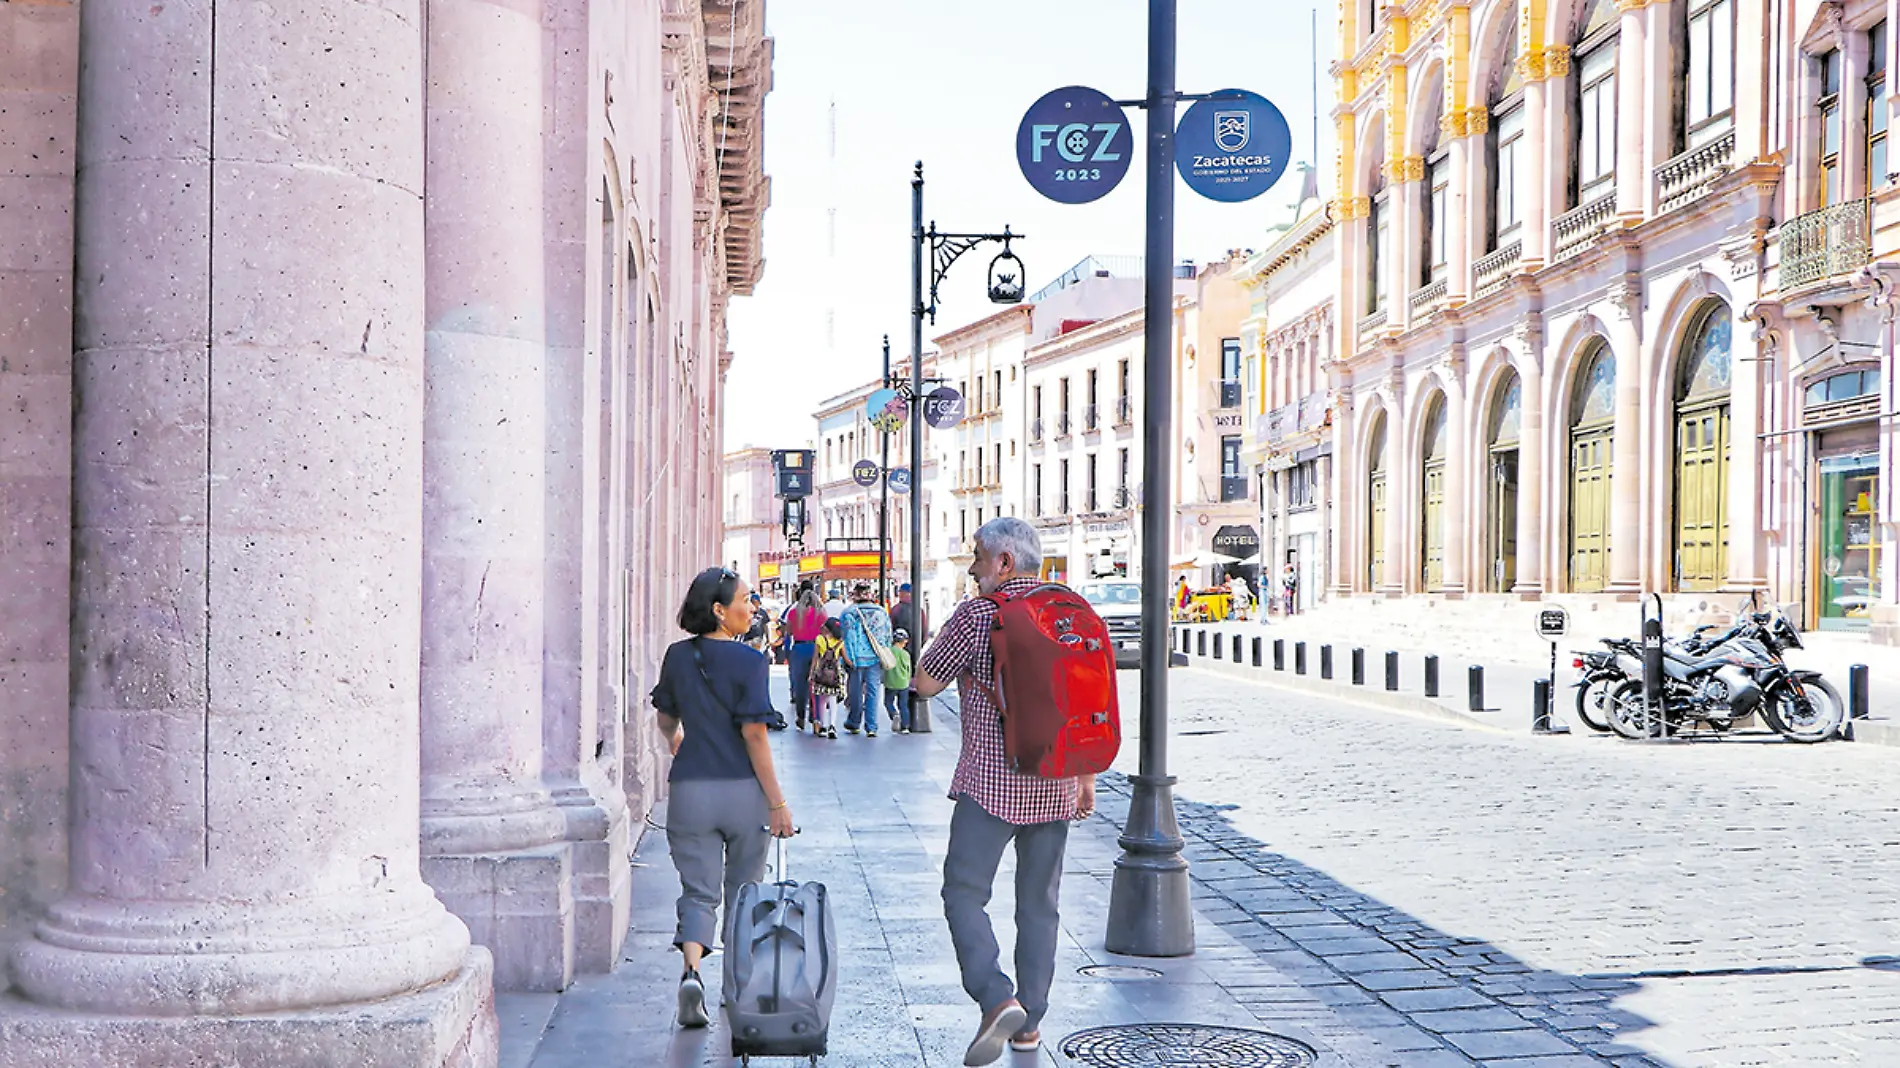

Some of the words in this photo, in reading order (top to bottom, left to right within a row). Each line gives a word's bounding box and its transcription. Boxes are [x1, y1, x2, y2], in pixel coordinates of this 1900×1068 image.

[1032, 123, 1121, 162] FCZ
[1193, 155, 1271, 167] Zacatecas
[1055, 169, 1100, 181] 2023
[928, 400, 961, 415] FCZ
[1217, 536, 1255, 545] HOTEL
